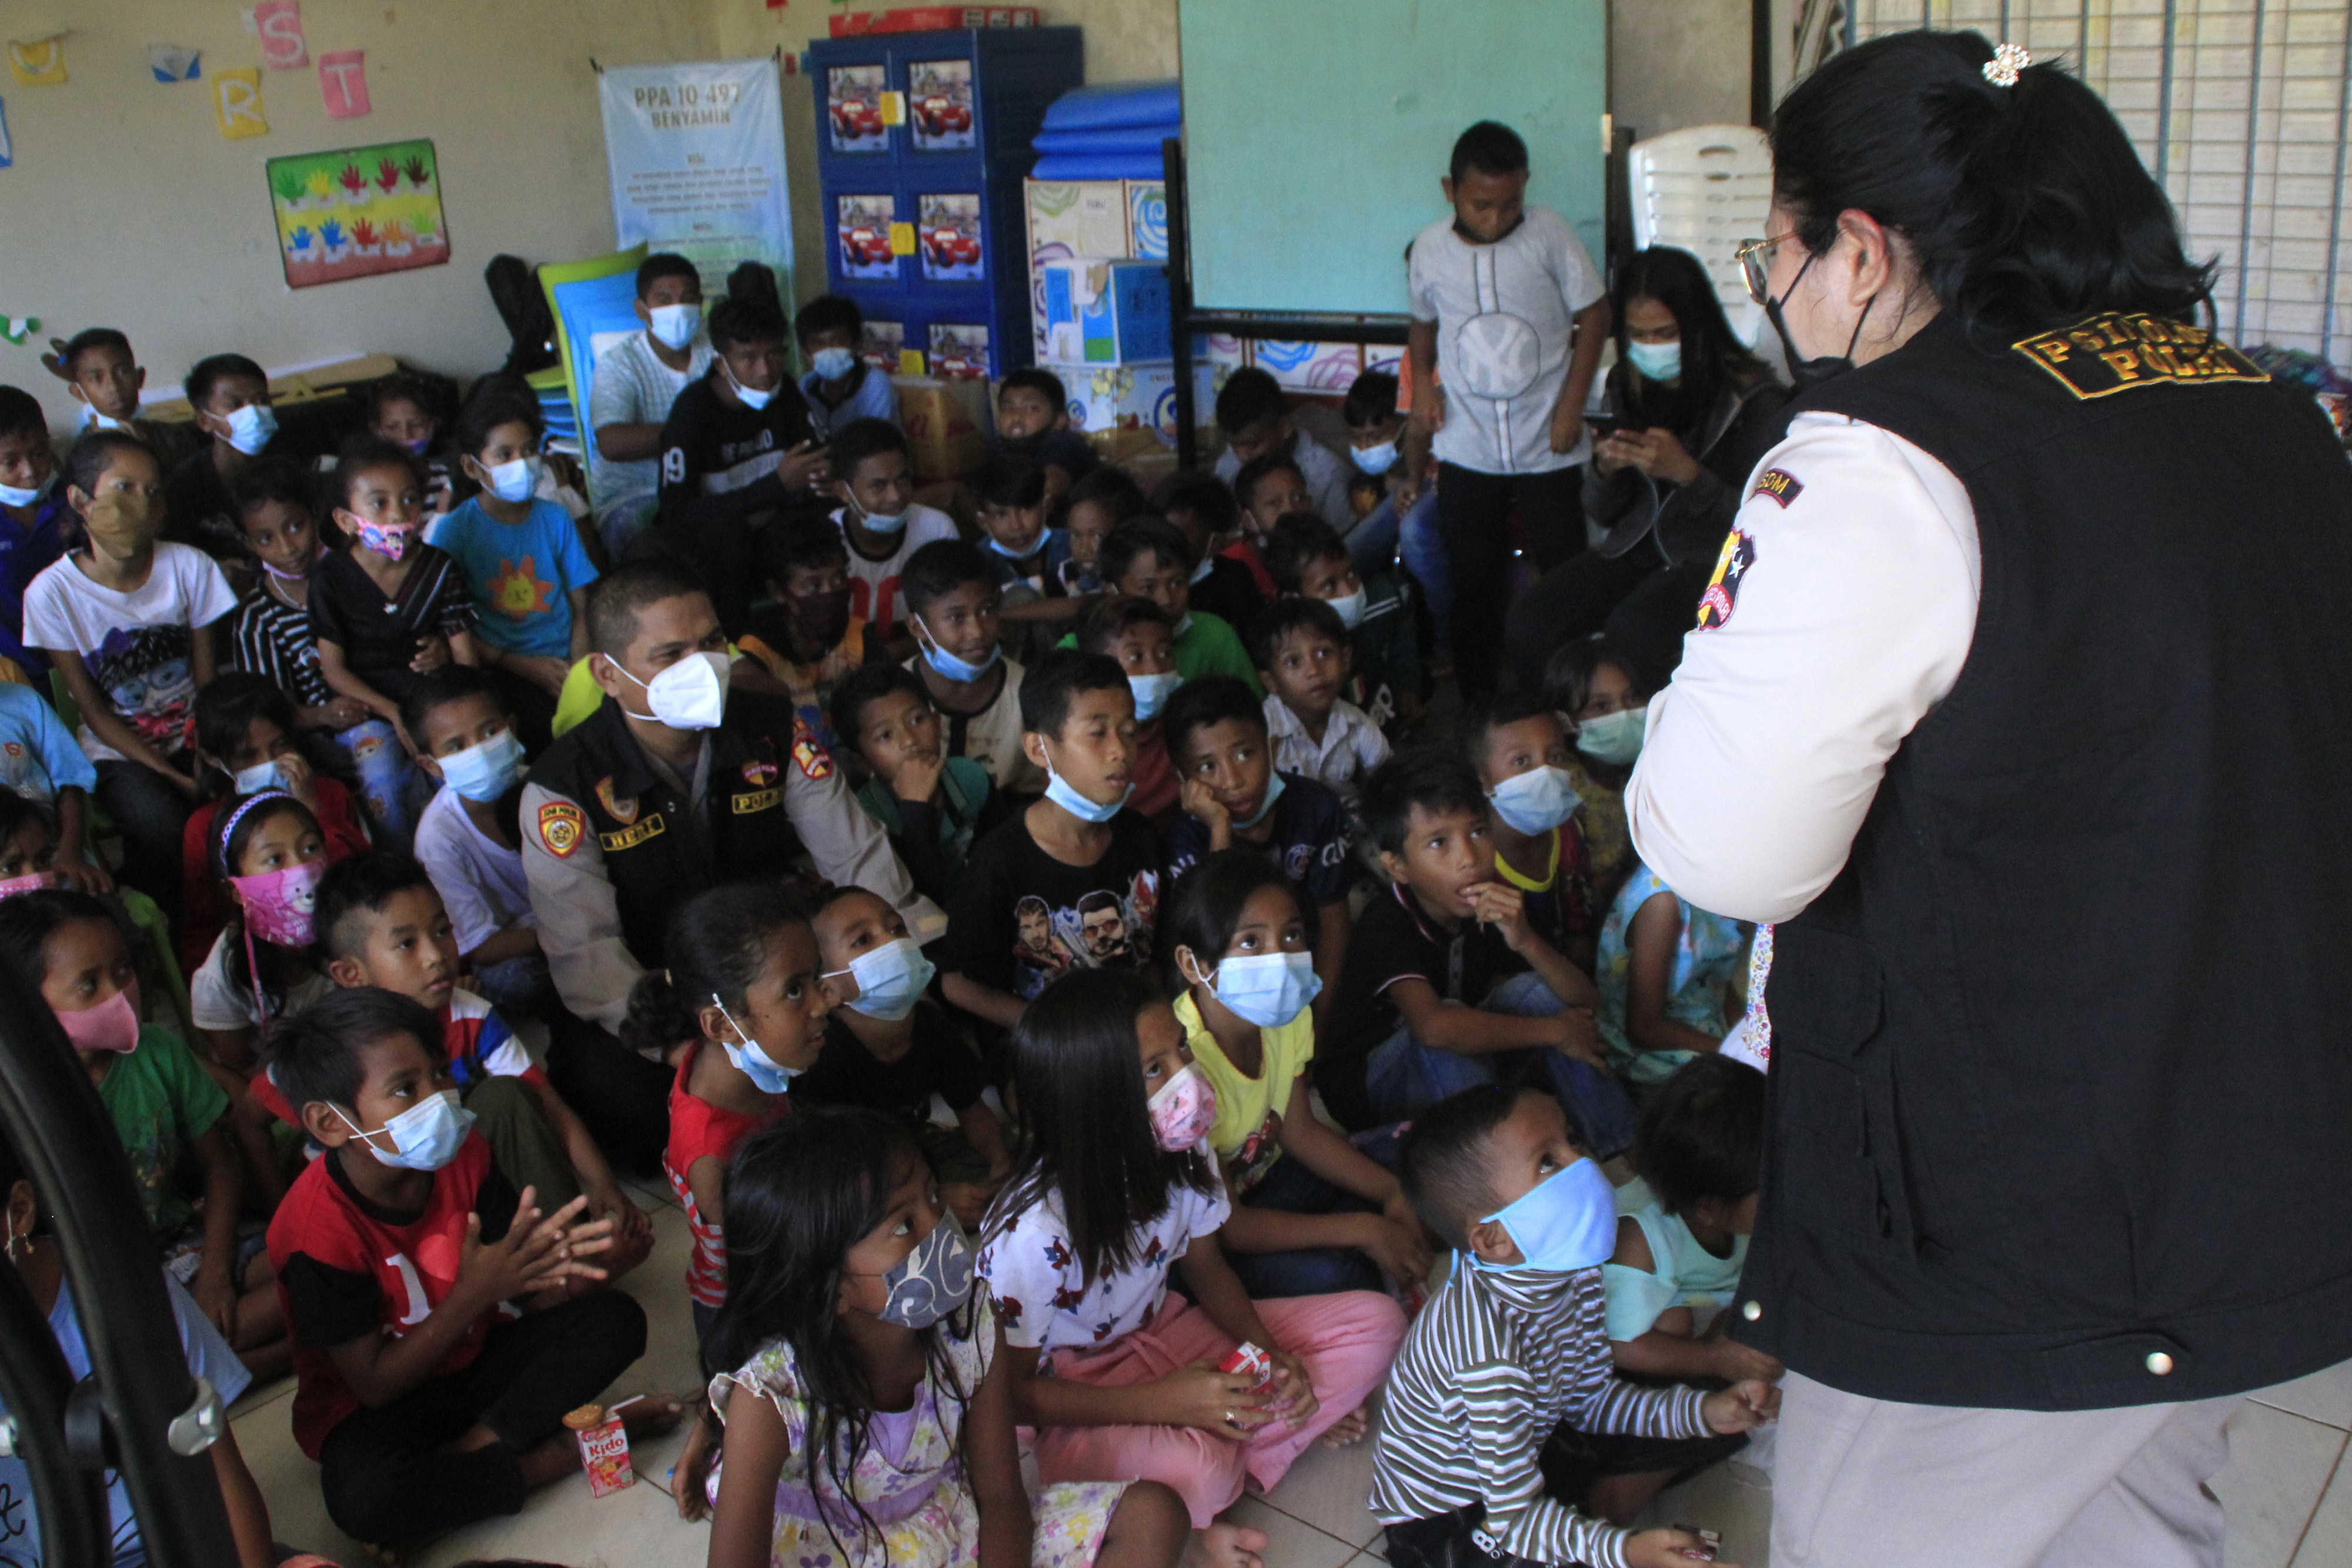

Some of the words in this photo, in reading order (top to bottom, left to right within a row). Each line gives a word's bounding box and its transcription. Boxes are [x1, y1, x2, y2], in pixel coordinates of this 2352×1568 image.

[263, 11, 305, 59] S
[219, 78, 263, 126] R
[325, 63, 359, 108] T
[634, 86, 672, 108] PPA
[651, 108, 731, 128] BENYAMIN
